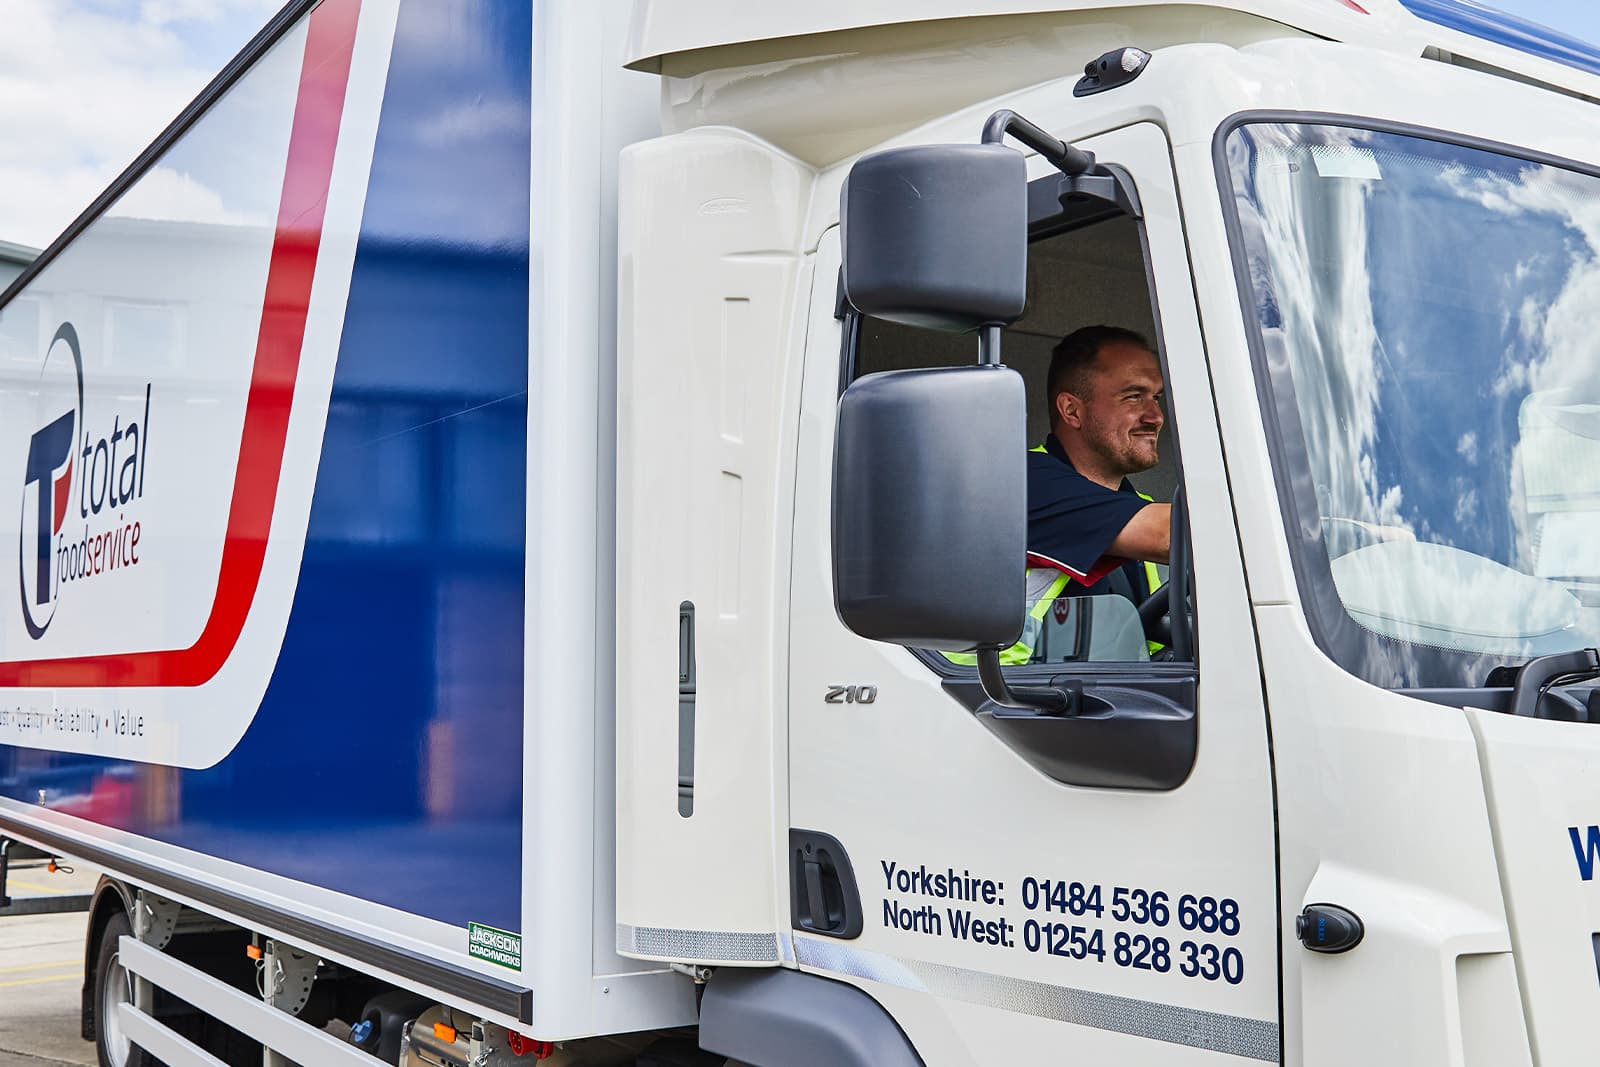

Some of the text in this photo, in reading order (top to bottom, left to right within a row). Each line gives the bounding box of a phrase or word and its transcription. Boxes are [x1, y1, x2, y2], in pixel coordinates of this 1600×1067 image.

[81, 383, 151, 519] total
[54, 514, 141, 600] foodservice
[825, 685, 877, 703] 210
[54, 708, 101, 739] Reliability
[114, 709, 144, 737] Value
[881, 860, 1240, 936] Yorkshire: 01484 536 688
[470, 925, 520, 955] JACKSON
[470, 944, 520, 967] COACHWORKS
[883, 899, 1244, 985] North West: 01254 828 330
